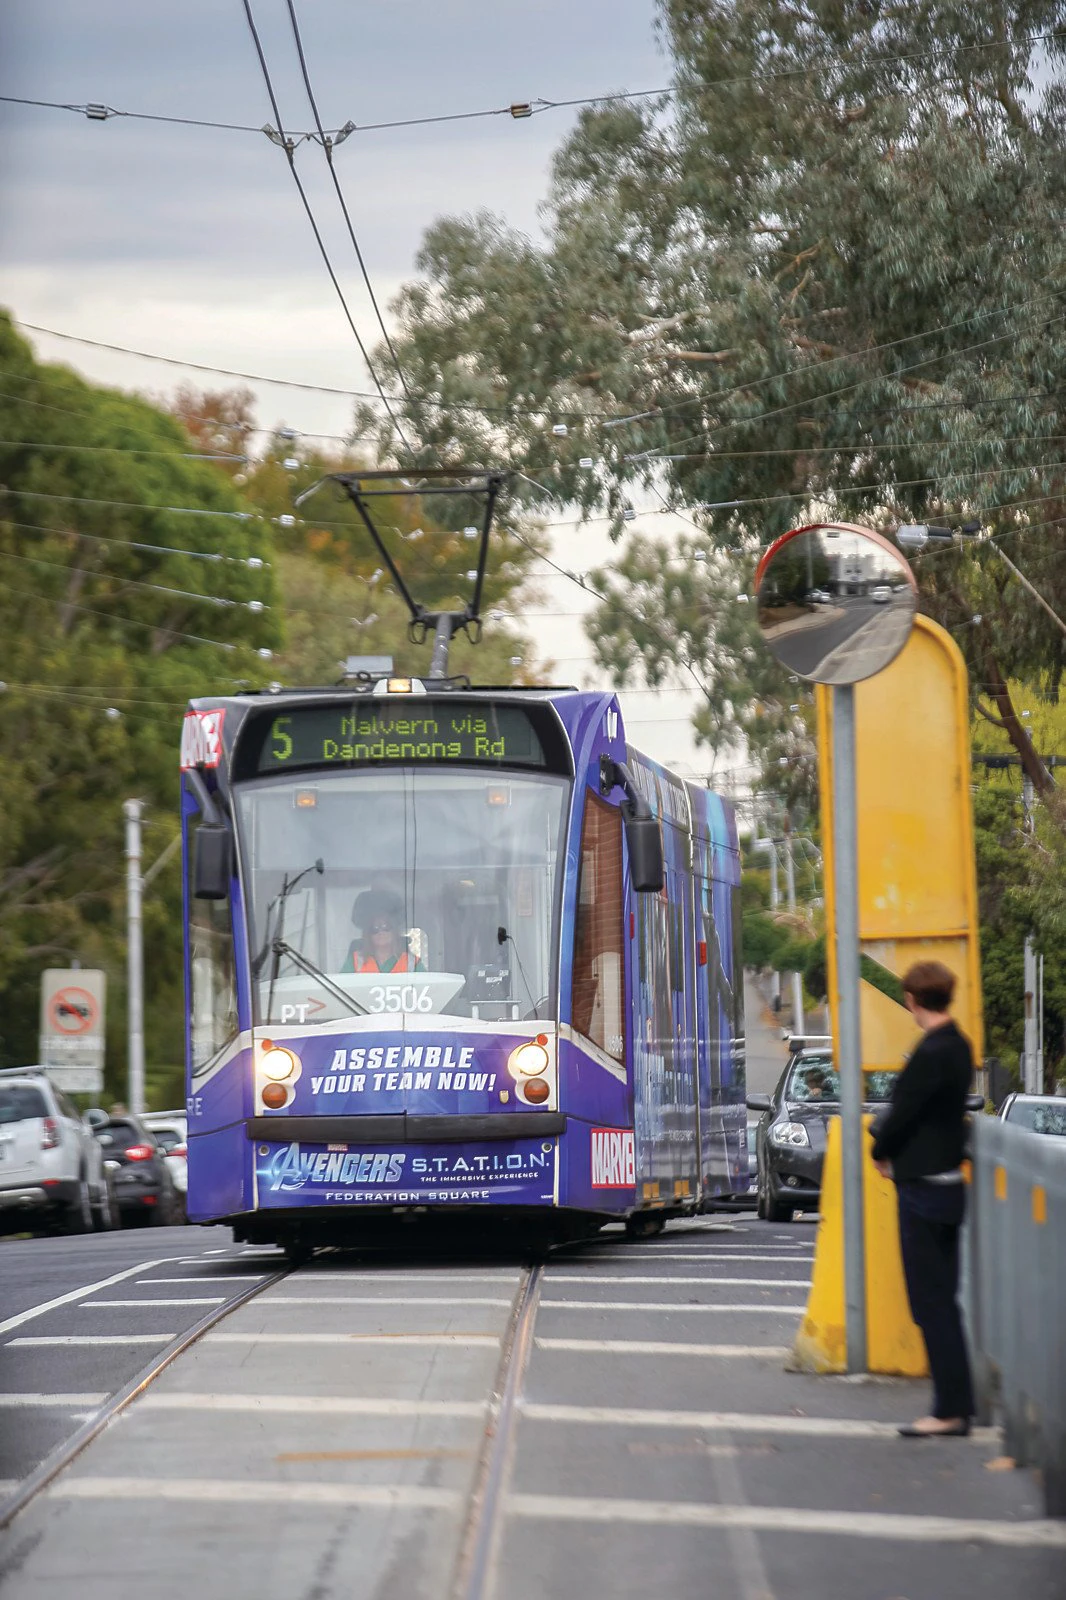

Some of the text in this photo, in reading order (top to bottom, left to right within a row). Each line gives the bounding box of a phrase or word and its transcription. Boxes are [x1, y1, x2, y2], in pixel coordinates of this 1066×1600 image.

[341, 714, 487, 735] Malvern via
[272, 717, 293, 760] 5
[323, 736, 505, 759] Dandenong Rd
[368, 985, 433, 1013] 3506
[330, 1046, 475, 1072] ASSEMBLE
[310, 1072, 497, 1095] YOUR TEAM NOW!
[270, 1142, 406, 1190] AVENGERS
[411, 1152, 550, 1173] S.T.A.T.I.O.N.
[440, 1174, 486, 1182] IMMERSIVE
[489, 1171, 539, 1180] EXPERIENCE
[325, 1190, 490, 1201] FEDERATION SQUARE
